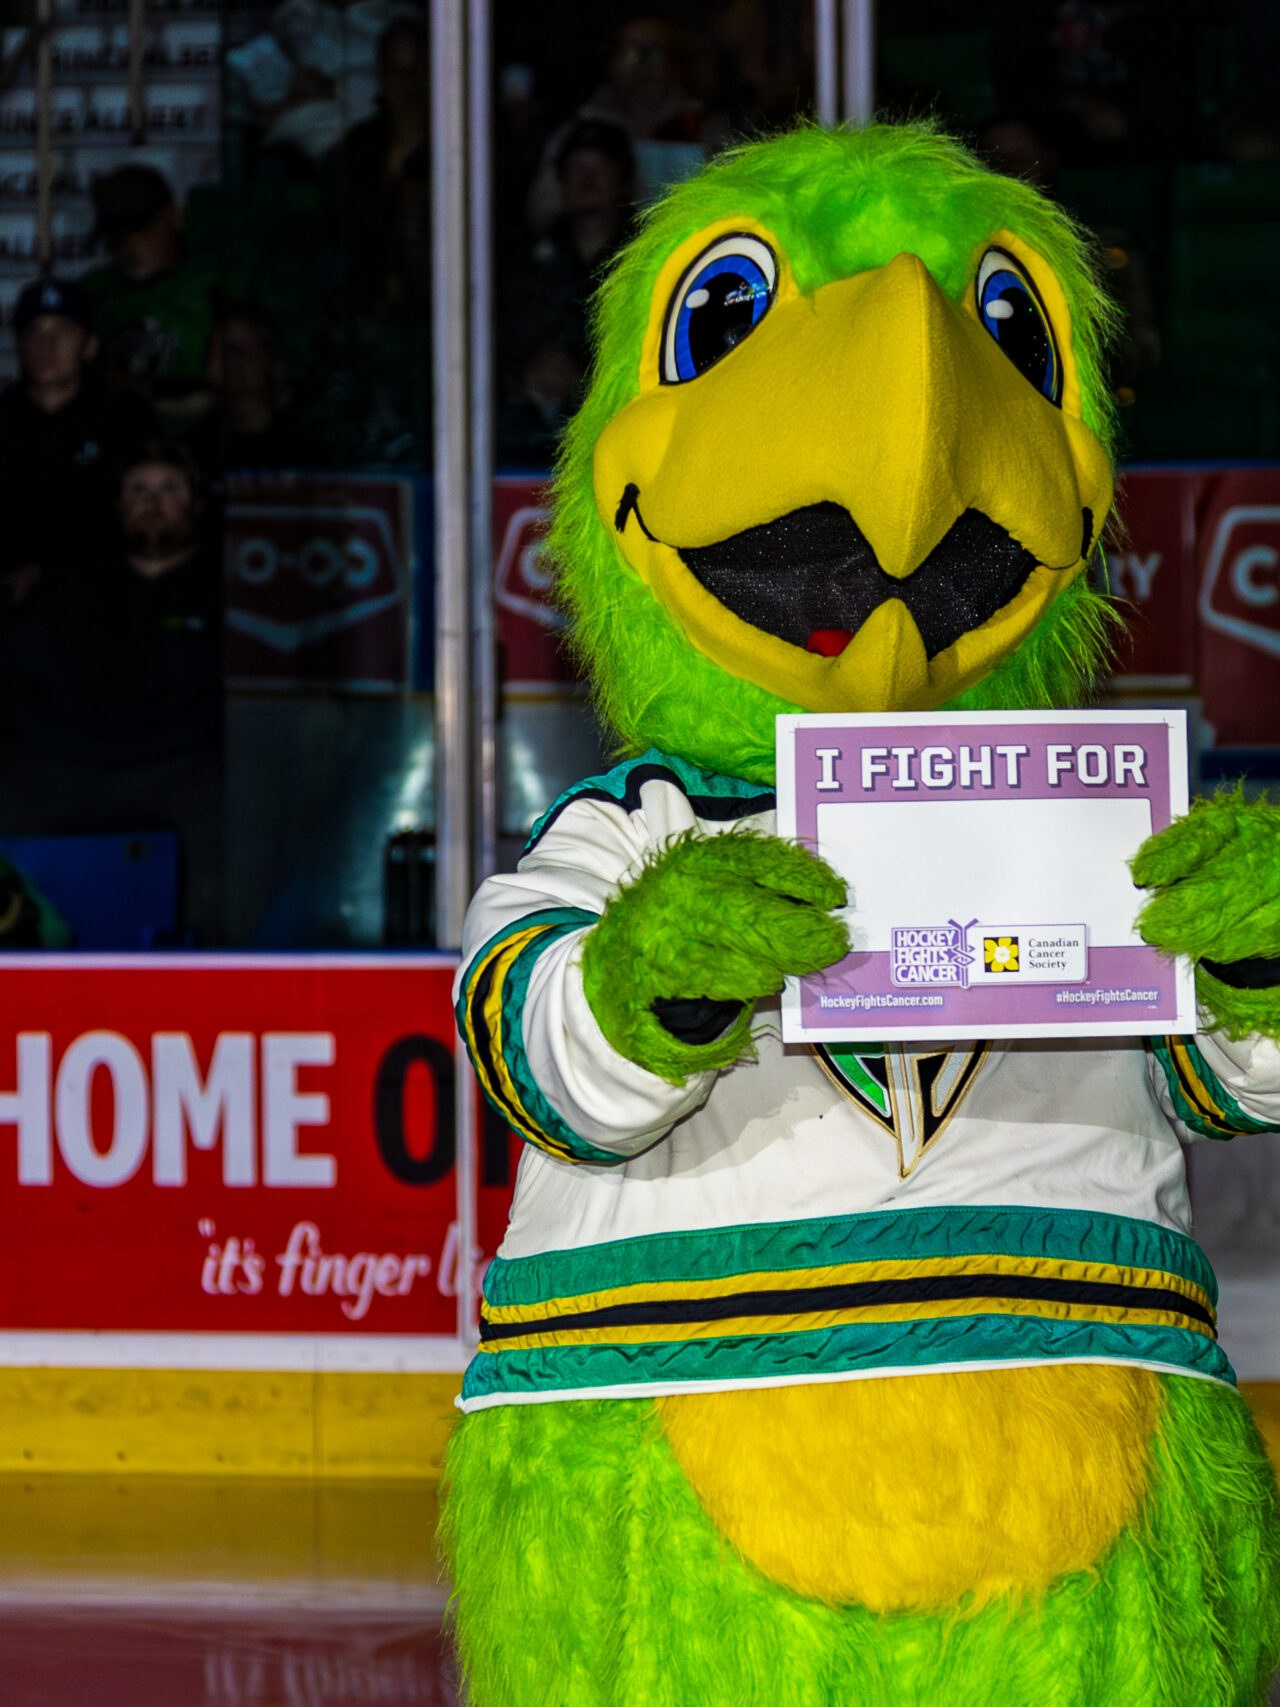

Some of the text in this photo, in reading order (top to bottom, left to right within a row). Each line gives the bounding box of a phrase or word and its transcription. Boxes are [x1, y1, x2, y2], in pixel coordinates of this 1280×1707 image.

[815, 743, 1148, 790] I FIGHT FOR
[896, 929, 957, 947] HOCKEY
[1027, 937, 1080, 949] Canadian
[895, 948, 949, 966] FIGHTS
[1027, 949, 1066, 960] Cancer
[1028, 958, 1068, 971] Society
[896, 964, 958, 983] CANCER
[820, 994, 943, 1010] HockeyFightsCancer.com
[1055, 988, 1159, 1005] #HockeyFightsCancer
[275, 1221, 431, 1320] finger
